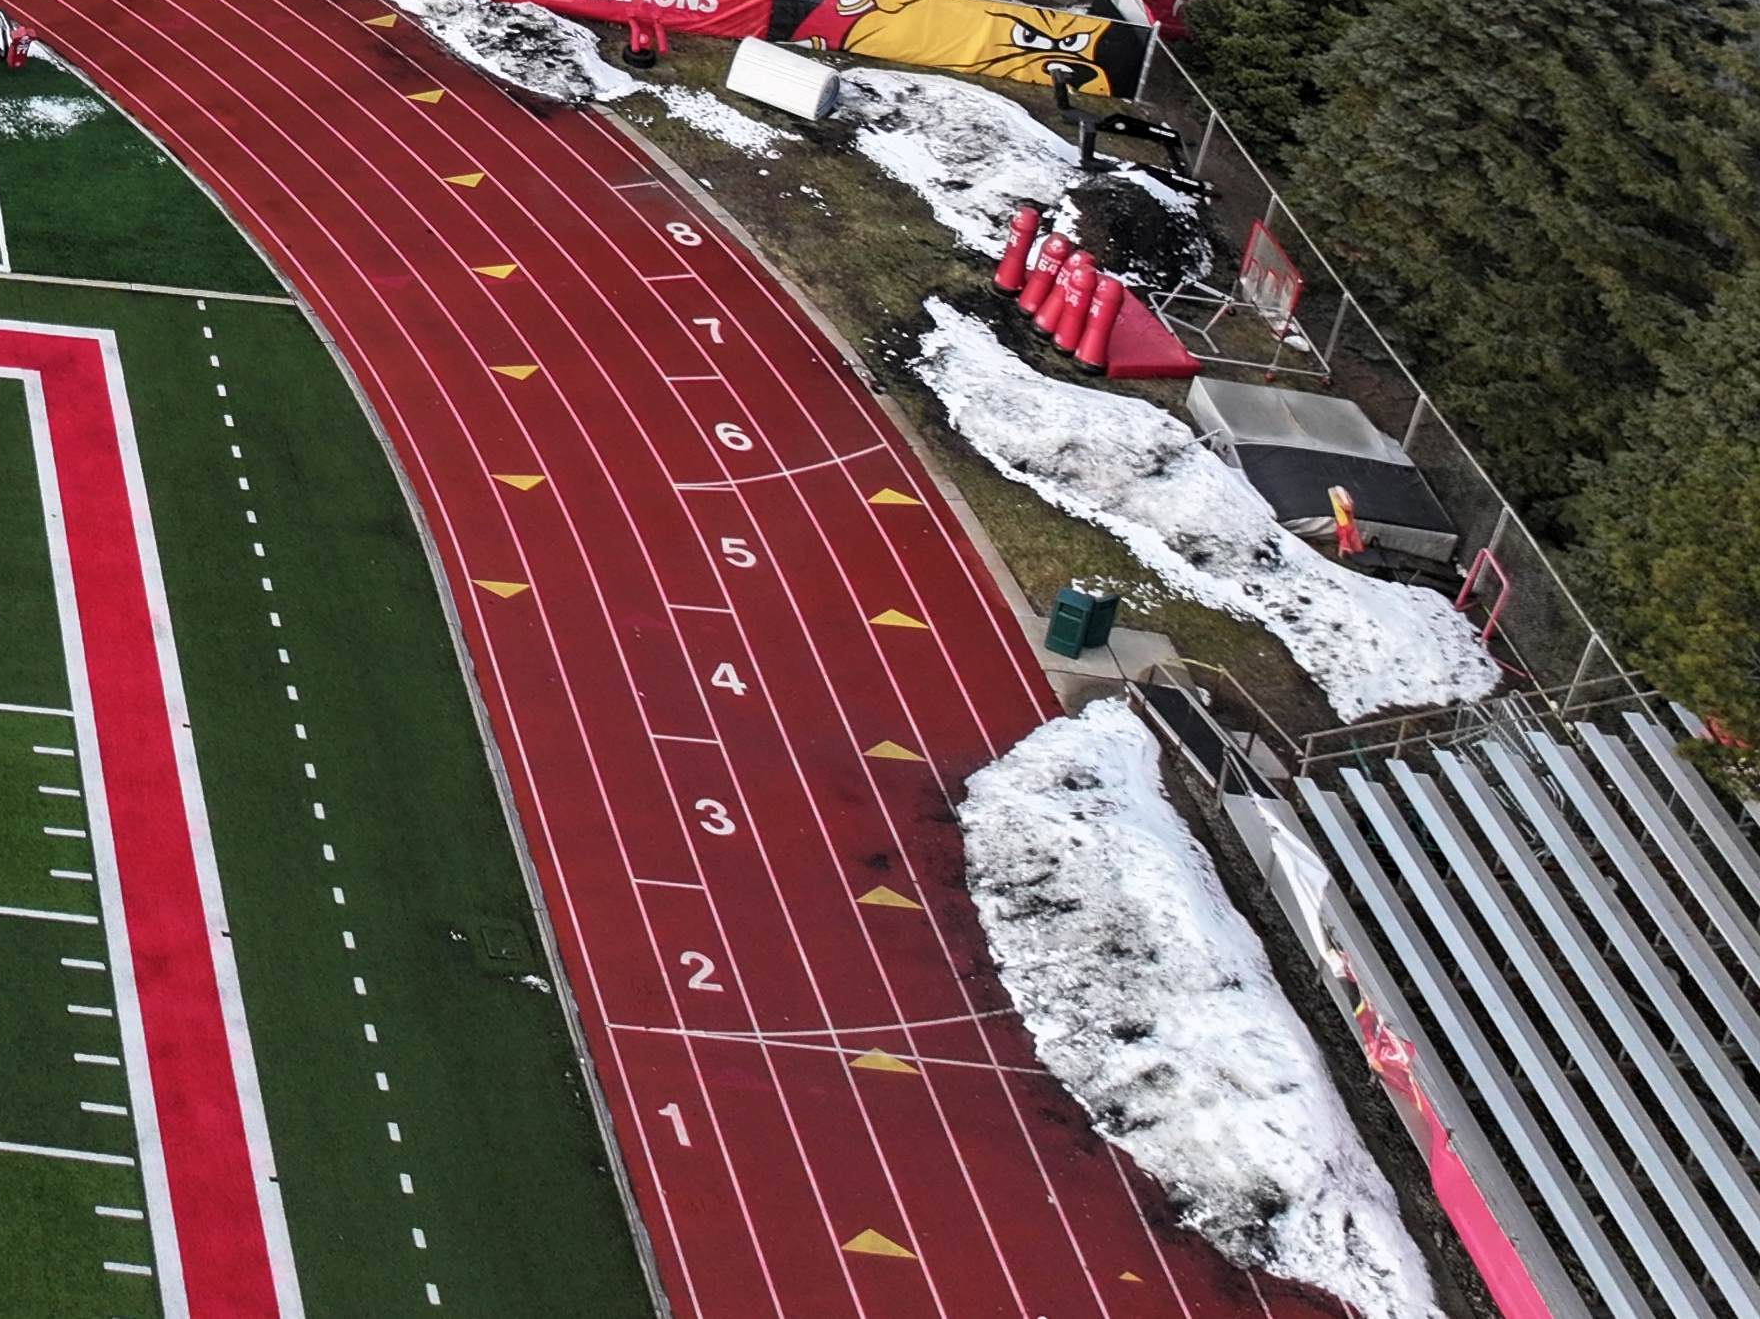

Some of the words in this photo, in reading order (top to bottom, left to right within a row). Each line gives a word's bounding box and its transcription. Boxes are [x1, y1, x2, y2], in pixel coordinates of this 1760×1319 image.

[666, 222, 702, 246] 8
[1037, 258, 1059, 275] 64
[692, 317, 726, 343] 7
[715, 423, 752, 451] 6
[720, 537, 757, 568] 5
[711, 662, 747, 696] 4
[695, 798, 736, 836] 3
[680, 951, 723, 991] 2
[658, 1102, 692, 1147] 1
